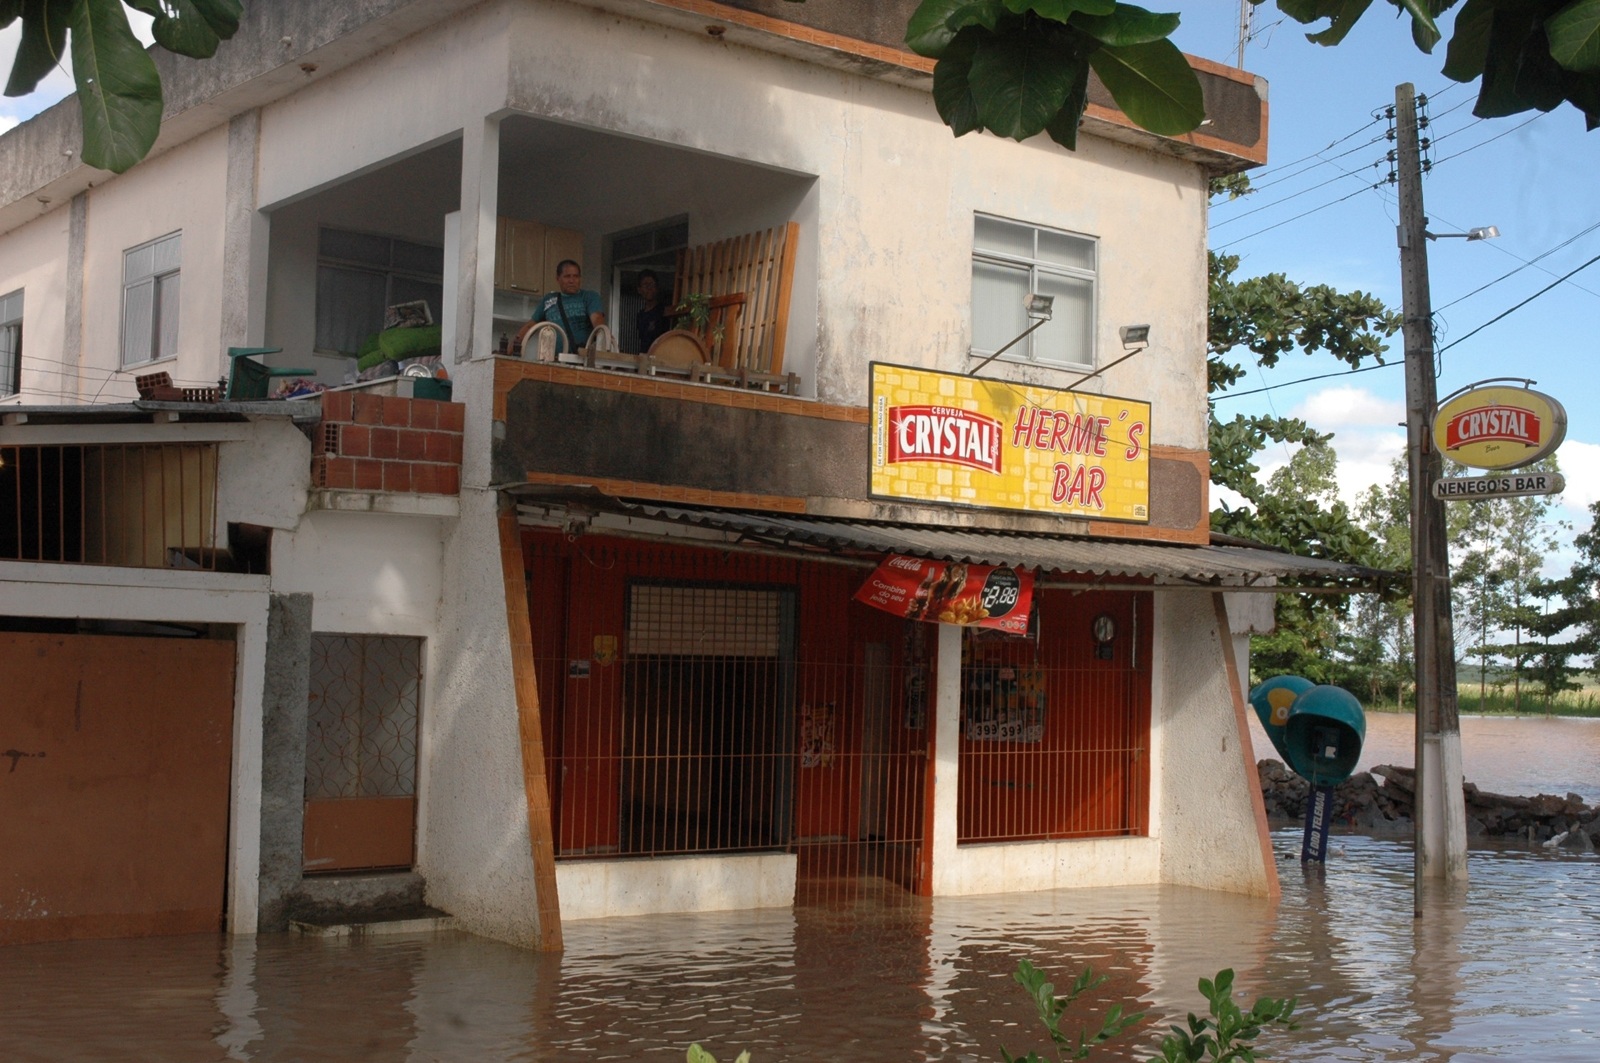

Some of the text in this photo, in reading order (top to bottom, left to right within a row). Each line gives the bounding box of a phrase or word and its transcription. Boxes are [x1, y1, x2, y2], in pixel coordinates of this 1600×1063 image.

[931, 407, 964, 418] CERVEJA
[1458, 410, 1528, 440] CRYSTAL
[900, 415, 993, 465] CRYSTAL
[1051, 462, 1107, 511] BAR
[1438, 477, 1546, 495] NENEGO'S BAR
[872, 580, 907, 595] Combine
[1312, 791, 1326, 830] TELEMAR
[1309, 831, 1321, 849] DDD
[1307, 848, 1319, 857] É
